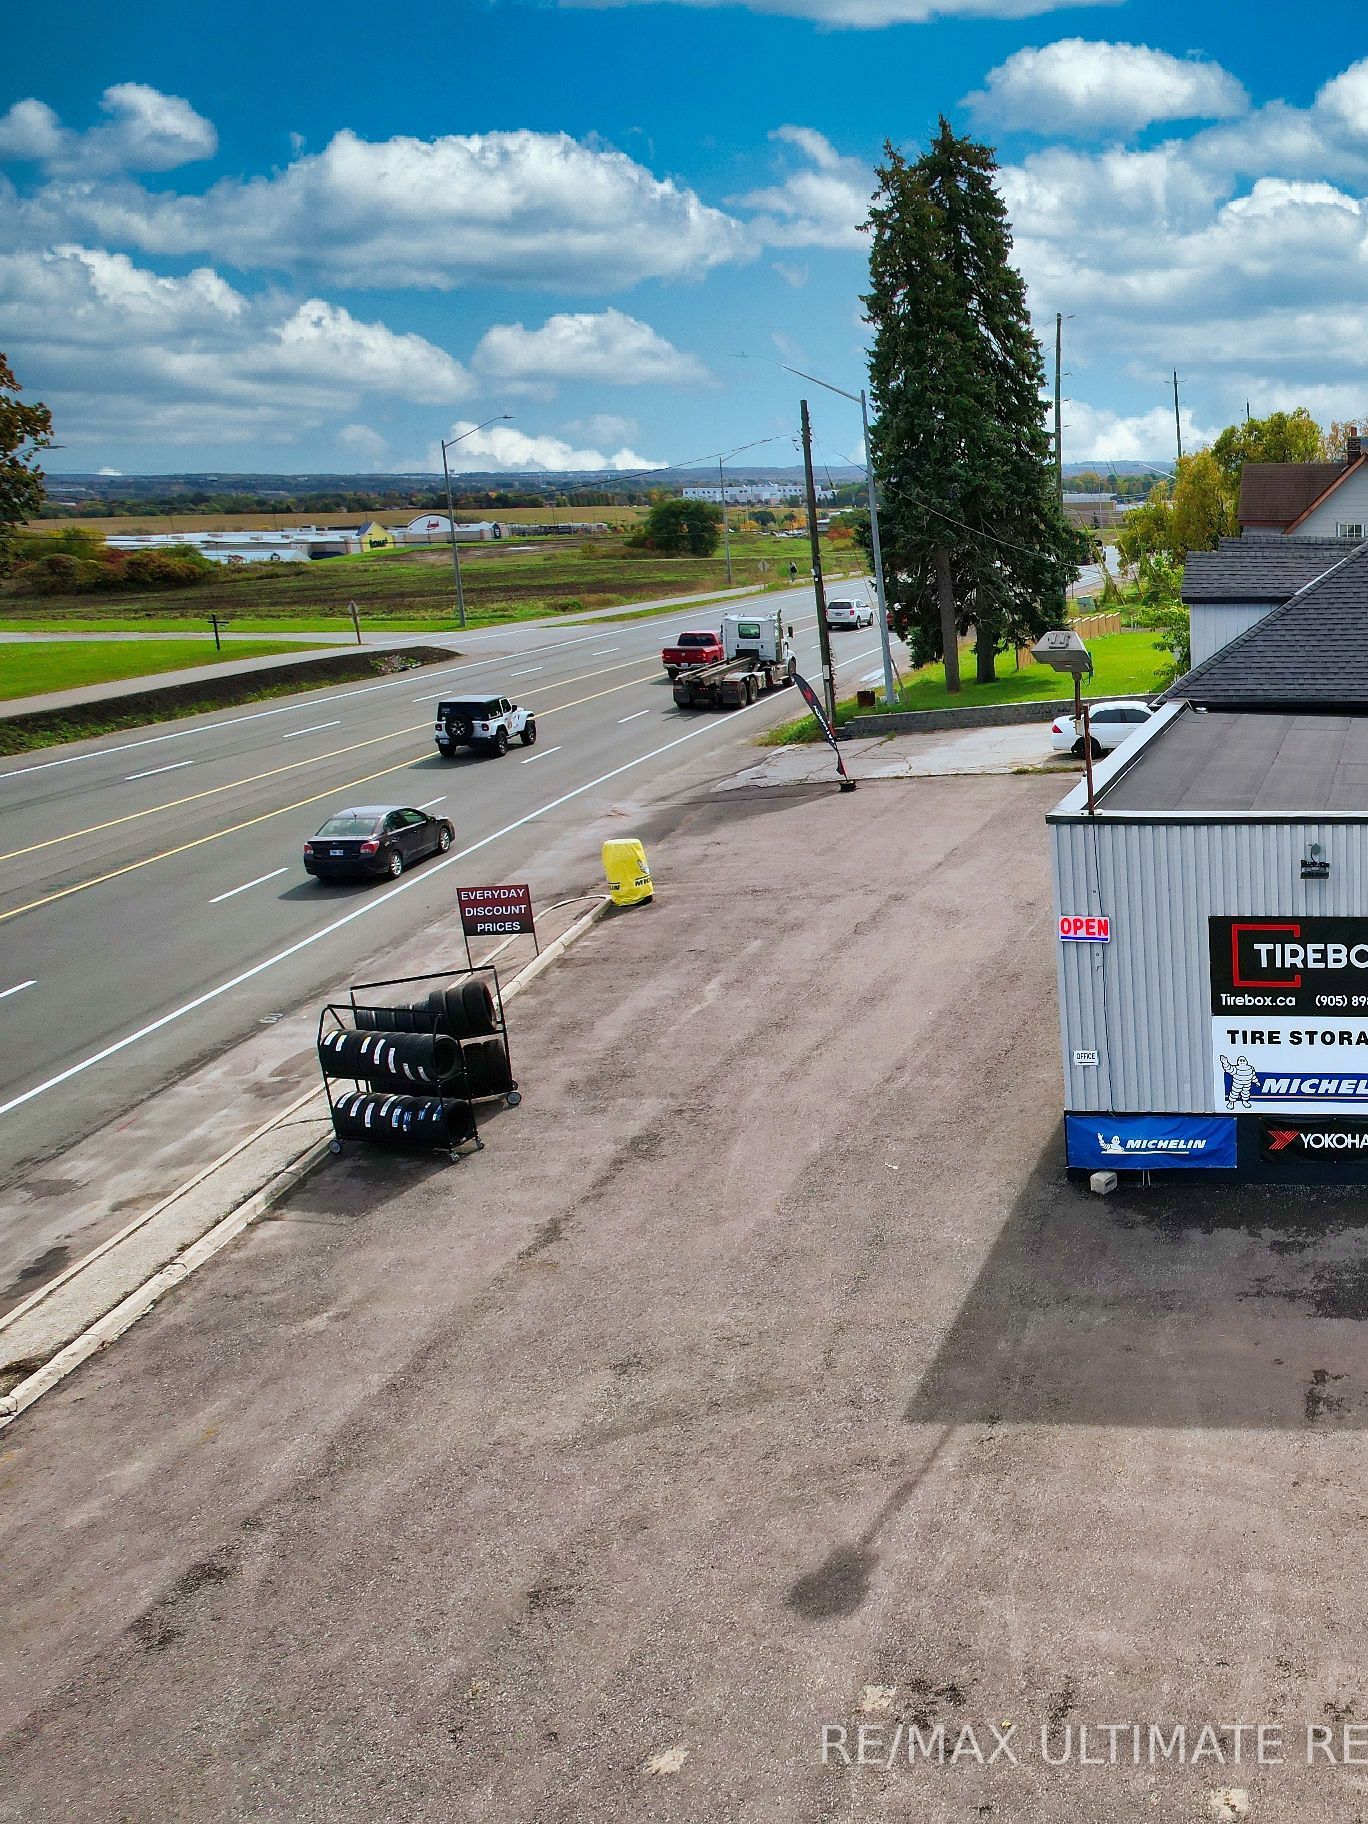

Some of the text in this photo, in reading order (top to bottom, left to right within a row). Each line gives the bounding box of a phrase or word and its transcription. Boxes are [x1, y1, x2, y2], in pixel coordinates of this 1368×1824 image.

[461, 888, 525, 900] EVERYDAY
[465, 905, 527, 916] DISCOUNT
[477, 922, 520, 932] PRICES
[1060, 917, 1109, 936] OPEN
[1220, 993, 1296, 1006] Tirebox.ca
[1315, 995, 1348, 1007] (905)
[1227, 1030, 1282, 1045] TIRE
[1076, 1052, 1096, 1060] OFFICE
[1126, 1138, 1208, 1149] MICHELIN
